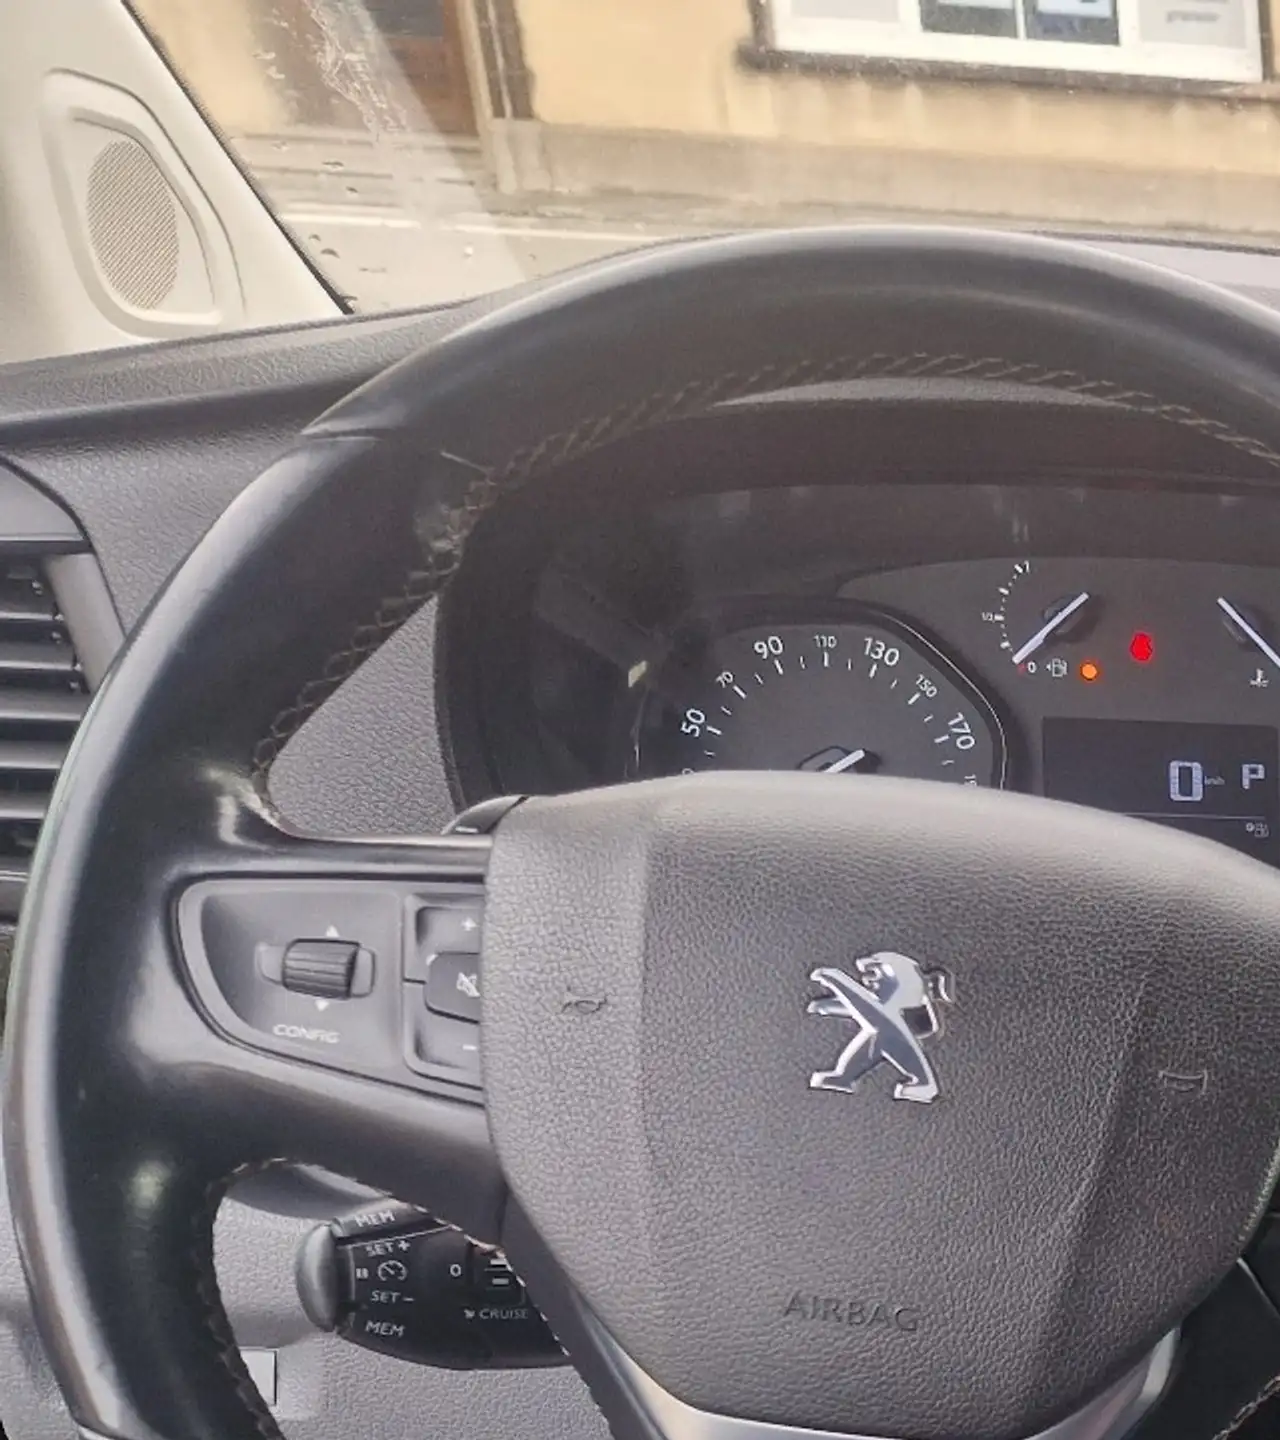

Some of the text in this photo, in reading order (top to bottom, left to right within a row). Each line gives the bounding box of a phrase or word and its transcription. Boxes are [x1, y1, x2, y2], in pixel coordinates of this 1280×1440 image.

[753, 636, 784, 660] 90
[813, 635, 837, 648] 110
[863, 637, 900, 667] 130
[715, 671, 734, 689] 70
[914, 673, 938, 698] 150
[680, 708, 705, 737] 50
[947, 712, 976, 750] 170
[1169, 760, 1204, 802] 0
[1241, 763, 1265, 790] P
[354, 1210, 396, 1228] MEM
[371, 1290, 401, 1304] SET
[478, 1307, 529, 1320] CRUISE
[783, 1291, 922, 1332] AIRBAG
[364, 1320, 406, 1337] MEM
